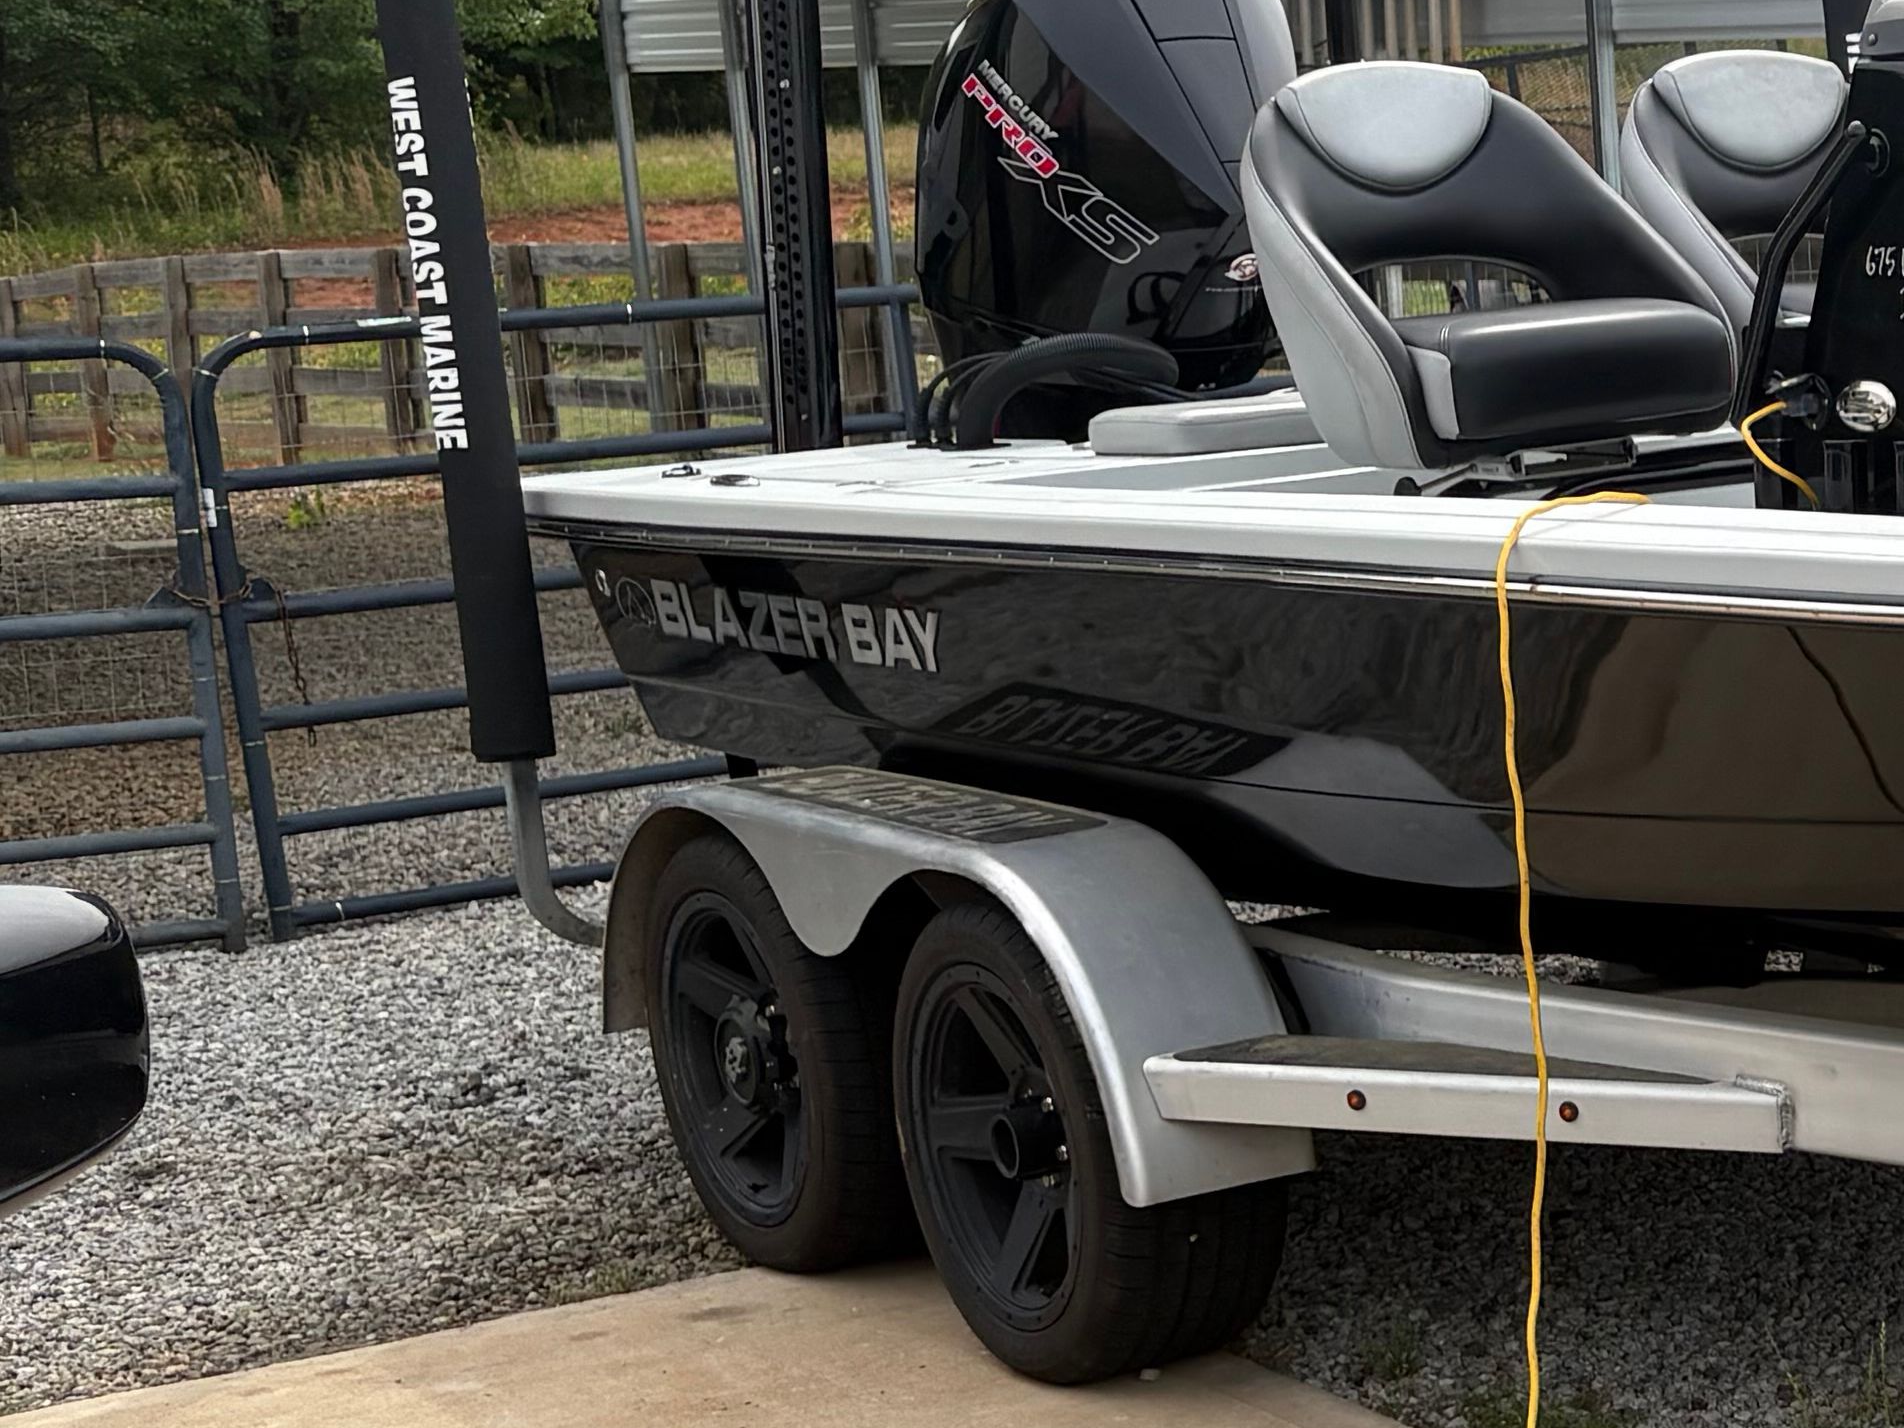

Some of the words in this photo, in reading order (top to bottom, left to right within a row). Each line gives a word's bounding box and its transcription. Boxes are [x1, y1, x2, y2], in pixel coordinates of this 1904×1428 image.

[387, 76, 429, 177] WEST
[961, 73, 1060, 179] PRO
[977, 59, 1060, 141] MERCURY
[402, 187, 448, 305] COAST
[997, 132, 1160, 264] XS
[1865, 245, 1897, 277] 675
[419, 314, 469, 451] MARINE
[650, 578, 839, 661] BLAZER
[841, 603, 940, 673] BAY
